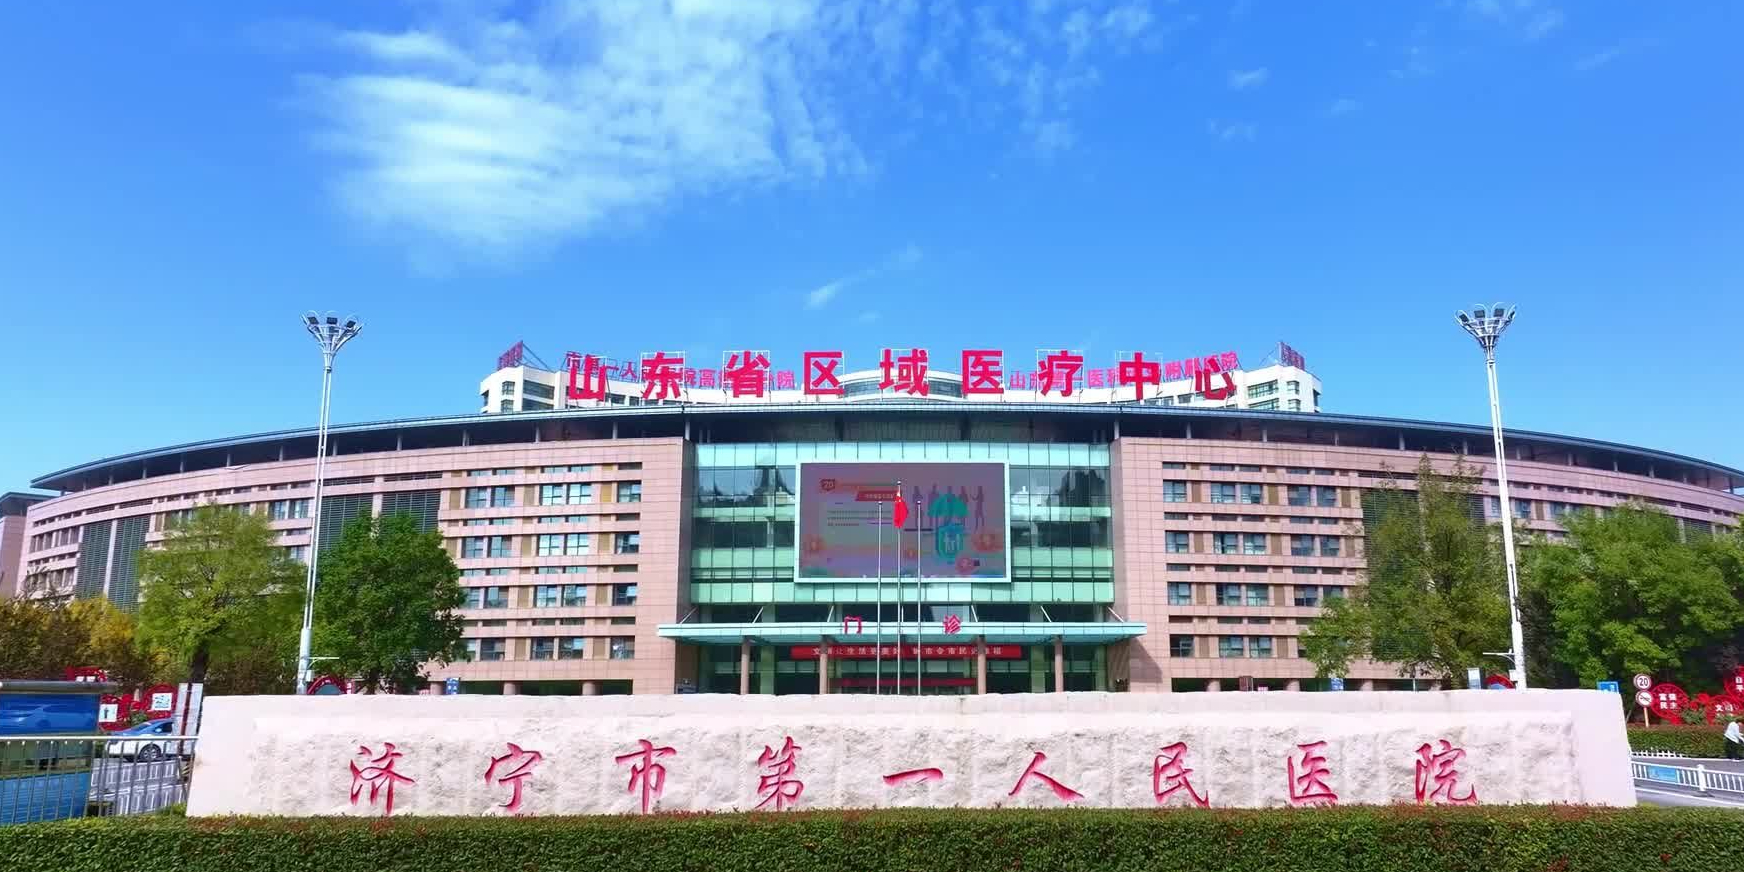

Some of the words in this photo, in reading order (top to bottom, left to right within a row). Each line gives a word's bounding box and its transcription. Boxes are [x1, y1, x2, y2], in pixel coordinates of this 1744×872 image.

[568, 348, 1235, 402] 山东省区域医疗中心
[843, 614, 962, 635] 门诊
[1638, 677, 1648, 687] 20
[350, 737, 1477, 811] 济宁市第一人民医院
